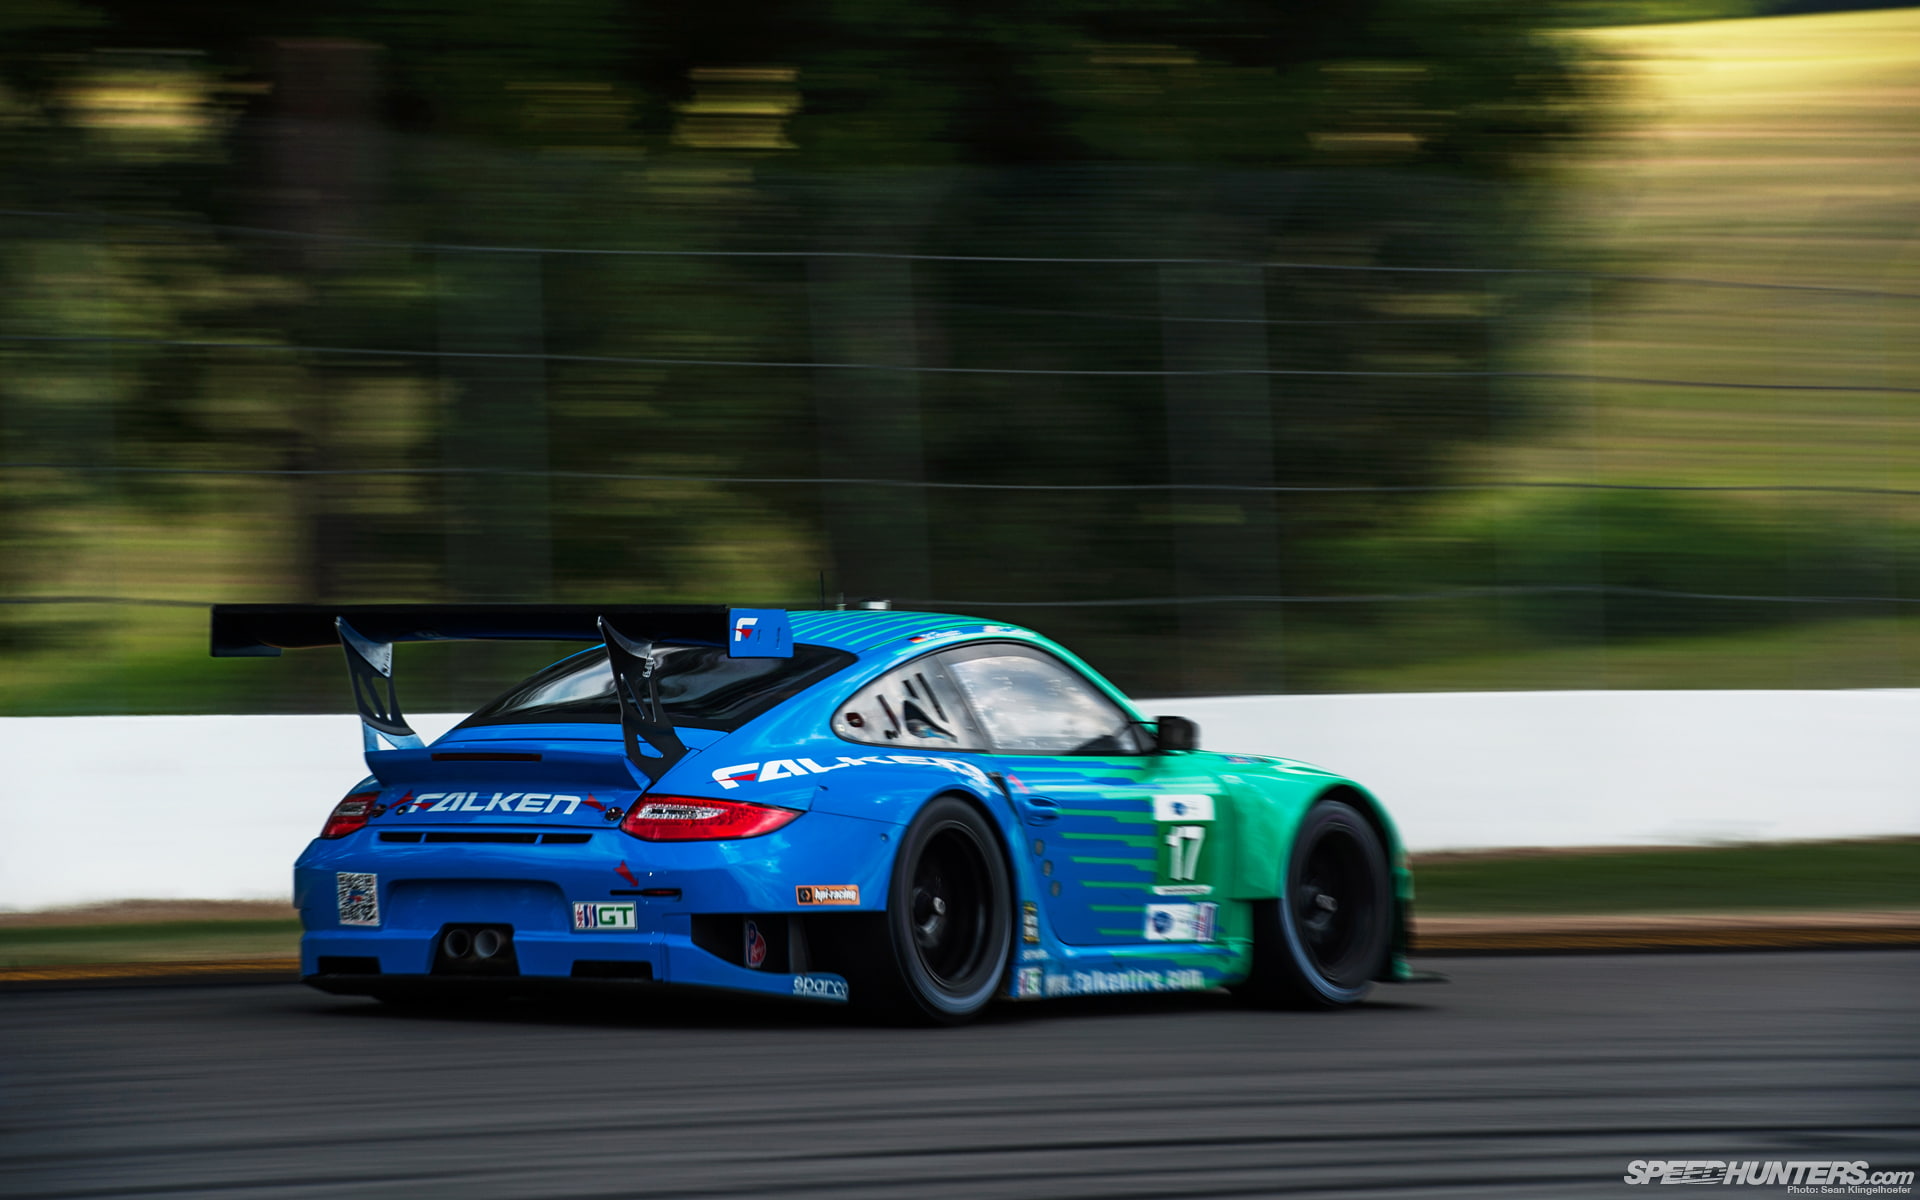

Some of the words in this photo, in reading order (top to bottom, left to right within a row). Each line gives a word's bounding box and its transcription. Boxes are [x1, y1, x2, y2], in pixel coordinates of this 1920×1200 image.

[712, 756, 993, 792] FALKEN
[408, 792, 581, 815] FALKEN
[1163, 826, 1205, 880] 17
[814, 887, 857, 902] hpi-racing
[598, 906, 634, 925] GT
